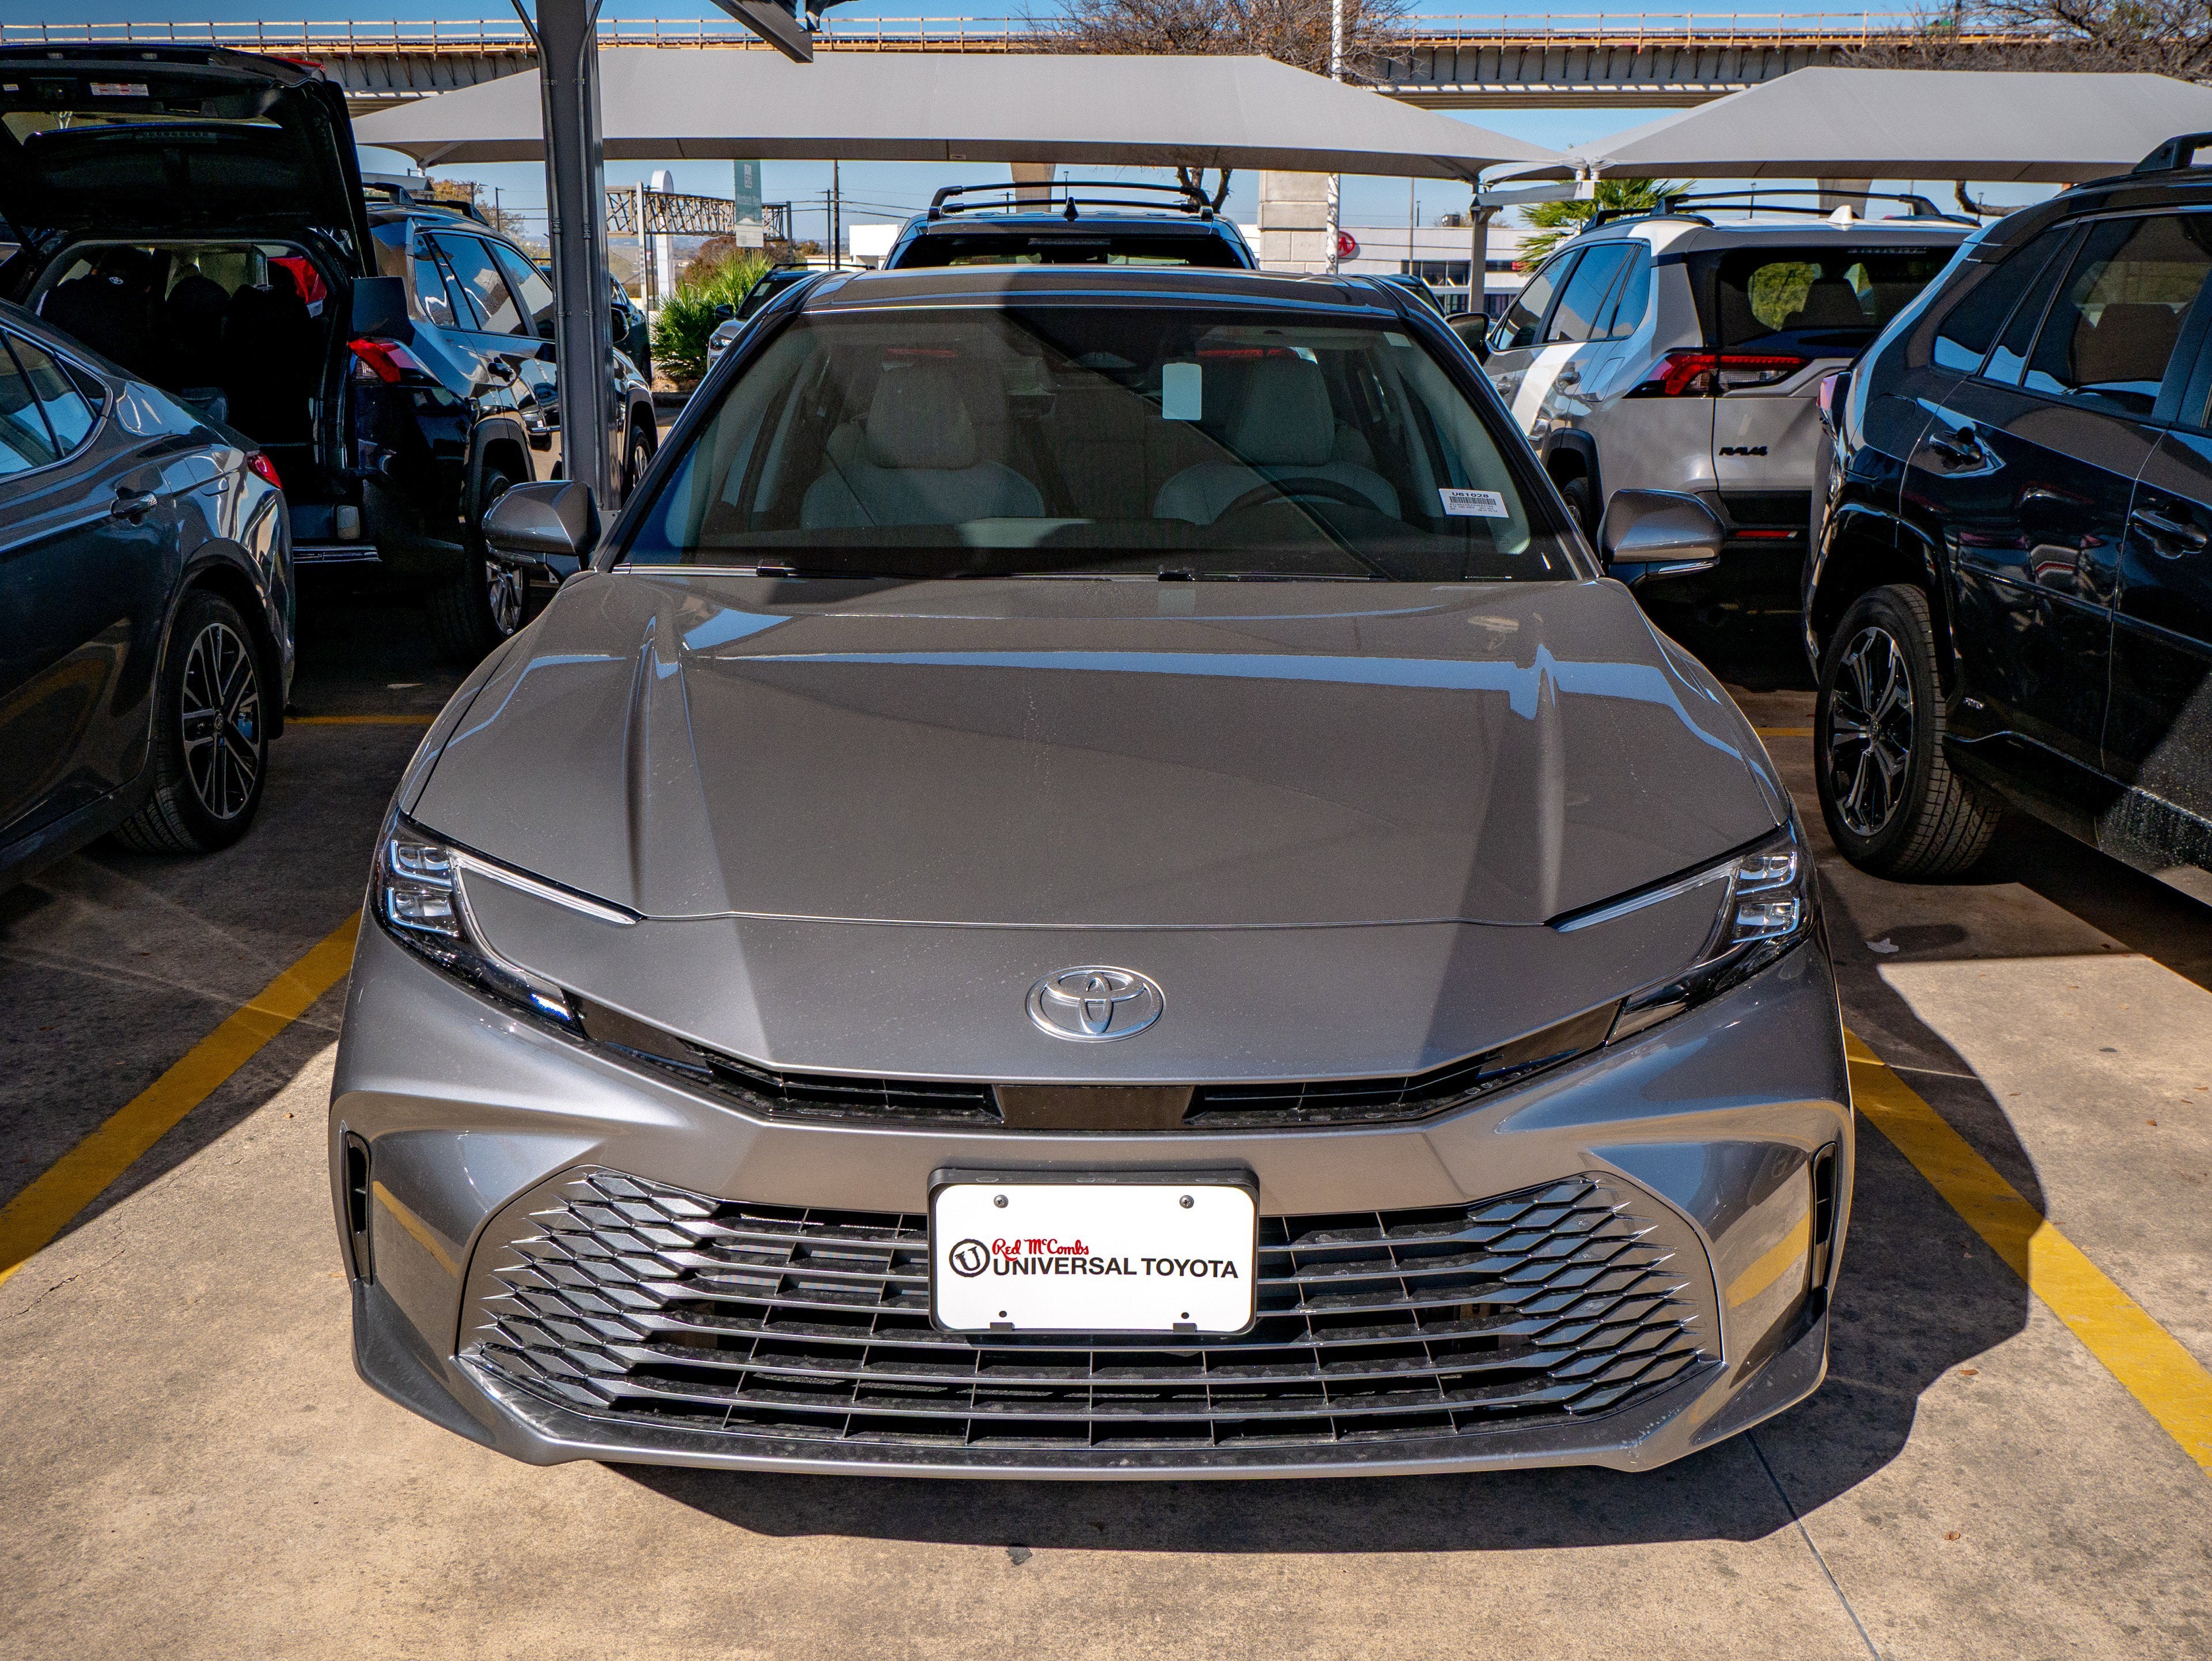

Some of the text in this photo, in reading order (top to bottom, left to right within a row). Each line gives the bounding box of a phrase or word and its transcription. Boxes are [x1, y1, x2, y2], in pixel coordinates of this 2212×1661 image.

[992, 1239, 1089, 1261] Red McCombs
[993, 1257, 1239, 1278] UNIVERSAL TOYOTA
